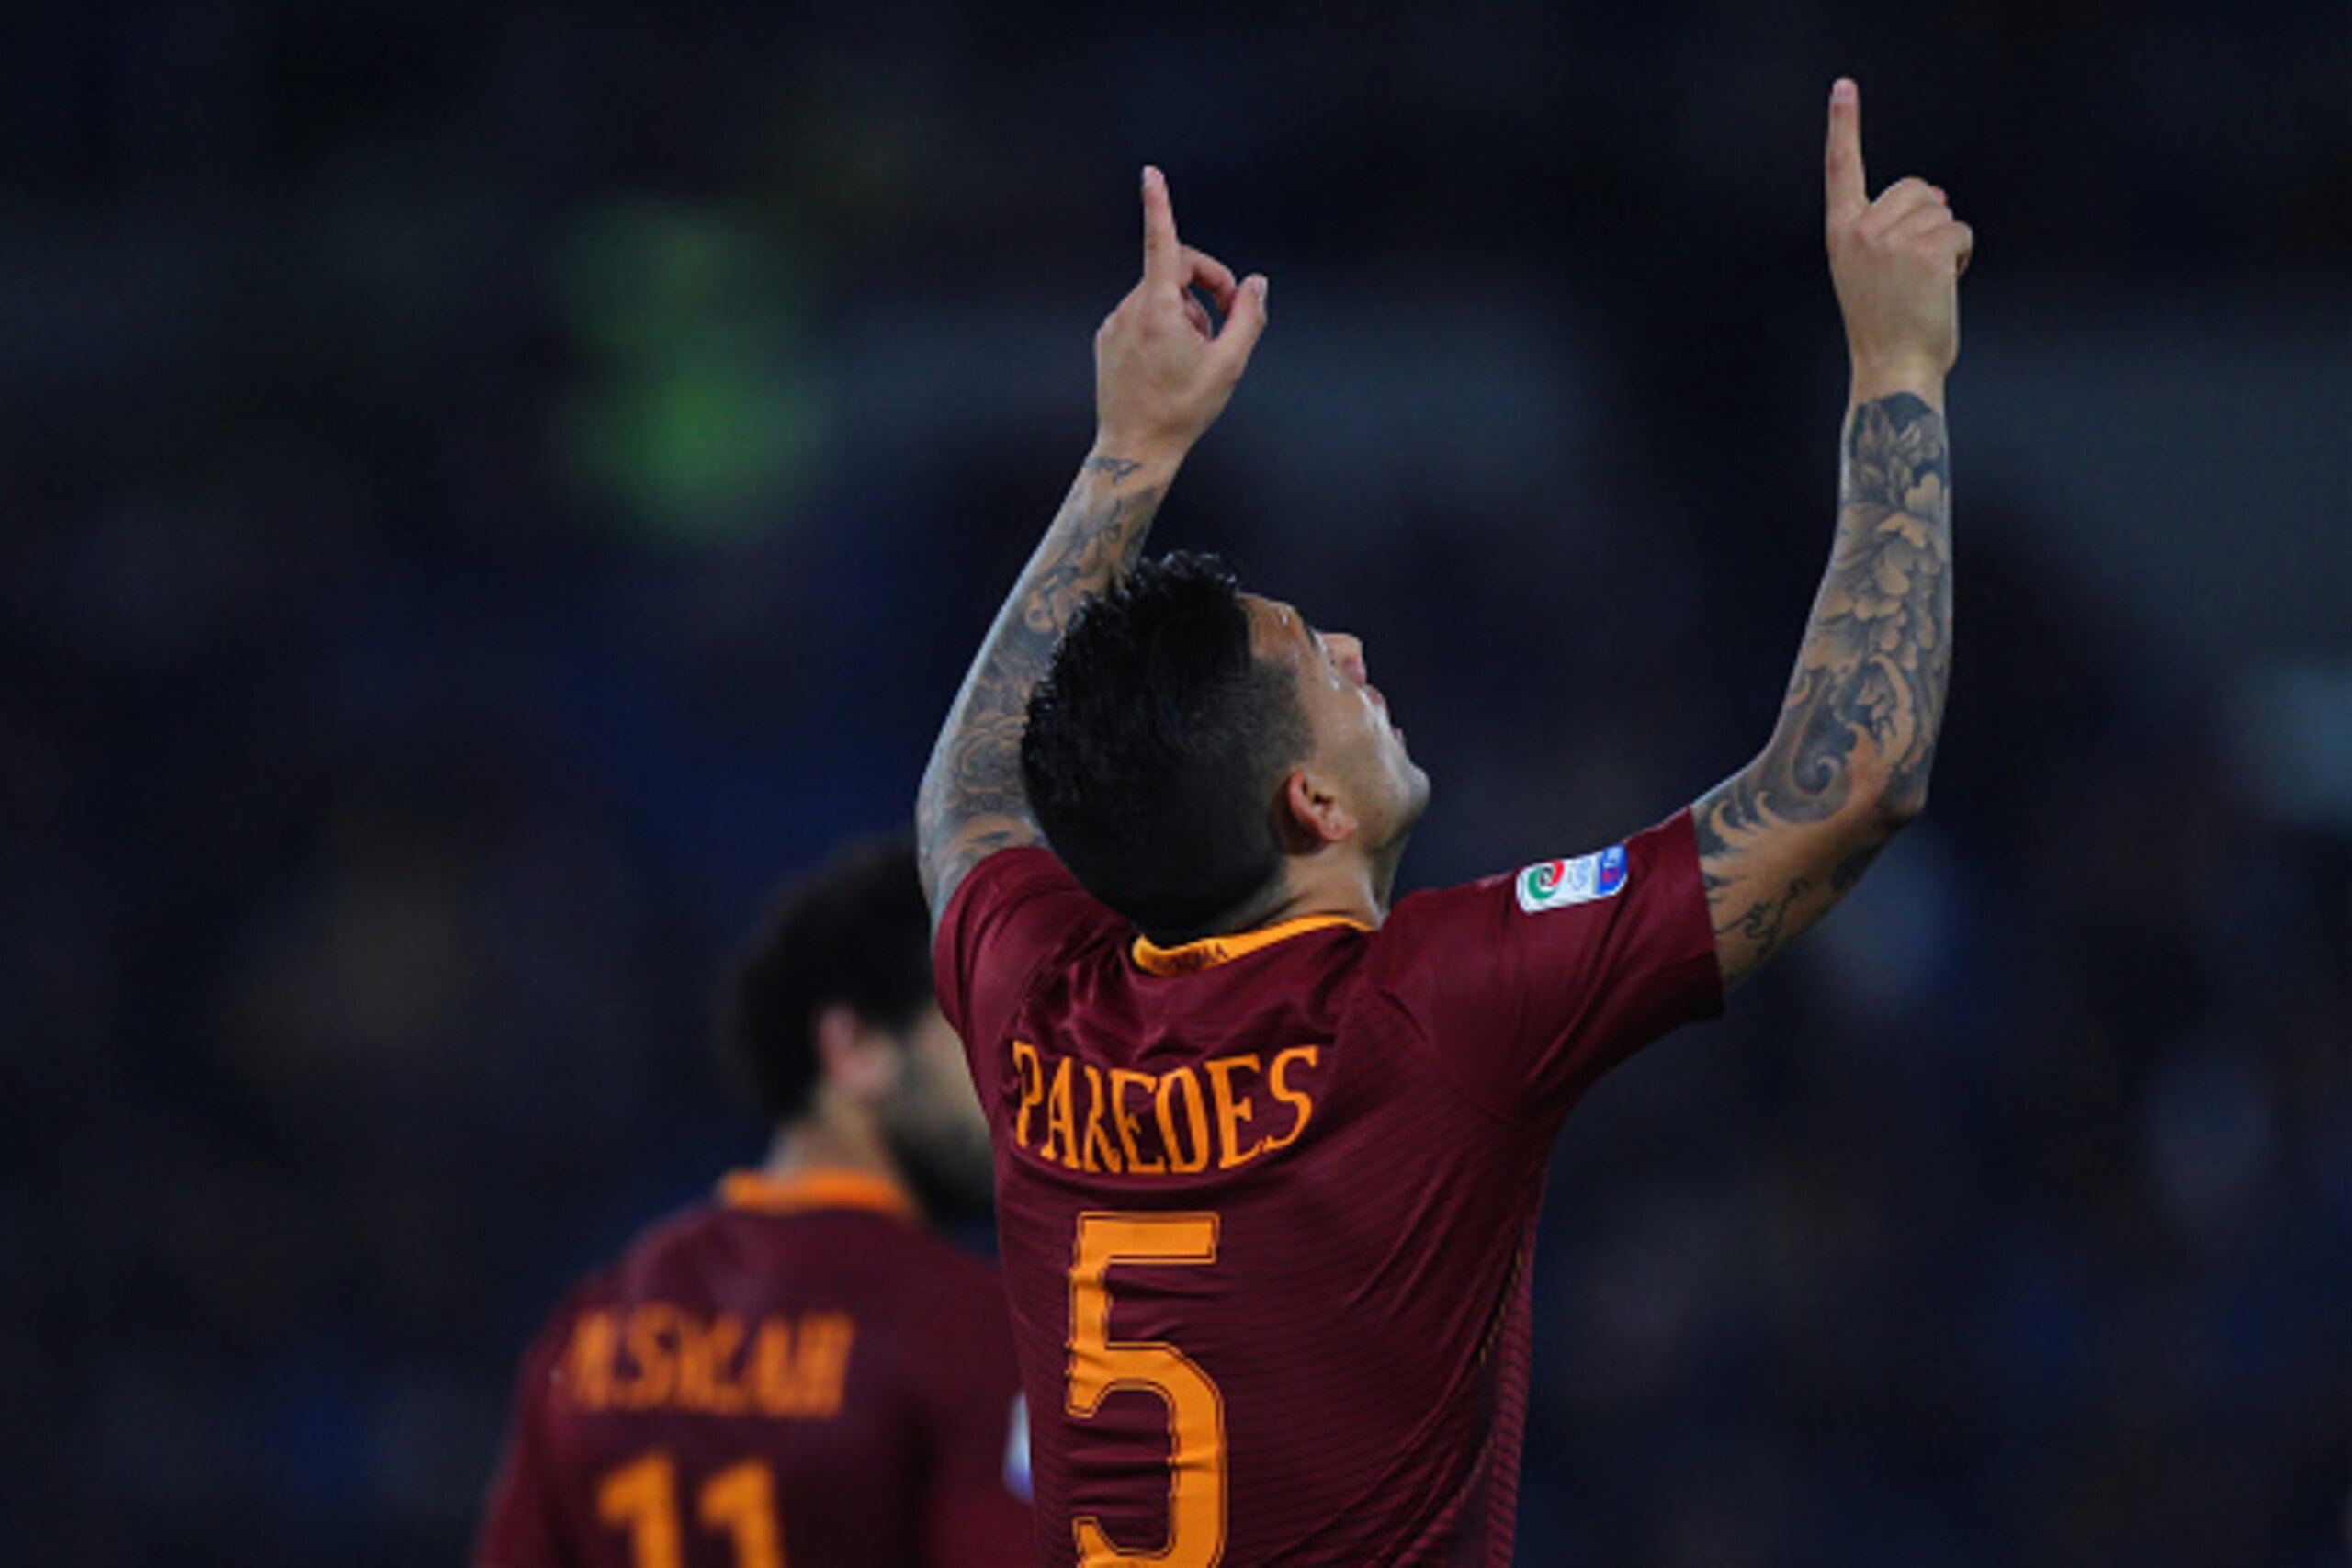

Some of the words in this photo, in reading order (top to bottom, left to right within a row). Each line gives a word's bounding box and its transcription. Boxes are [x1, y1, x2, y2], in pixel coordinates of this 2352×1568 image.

[1013, 1040, 1318, 1174] PAREDES
[1066, 1211, 1228, 1568] 5
[598, 1452, 784, 1568] 11
